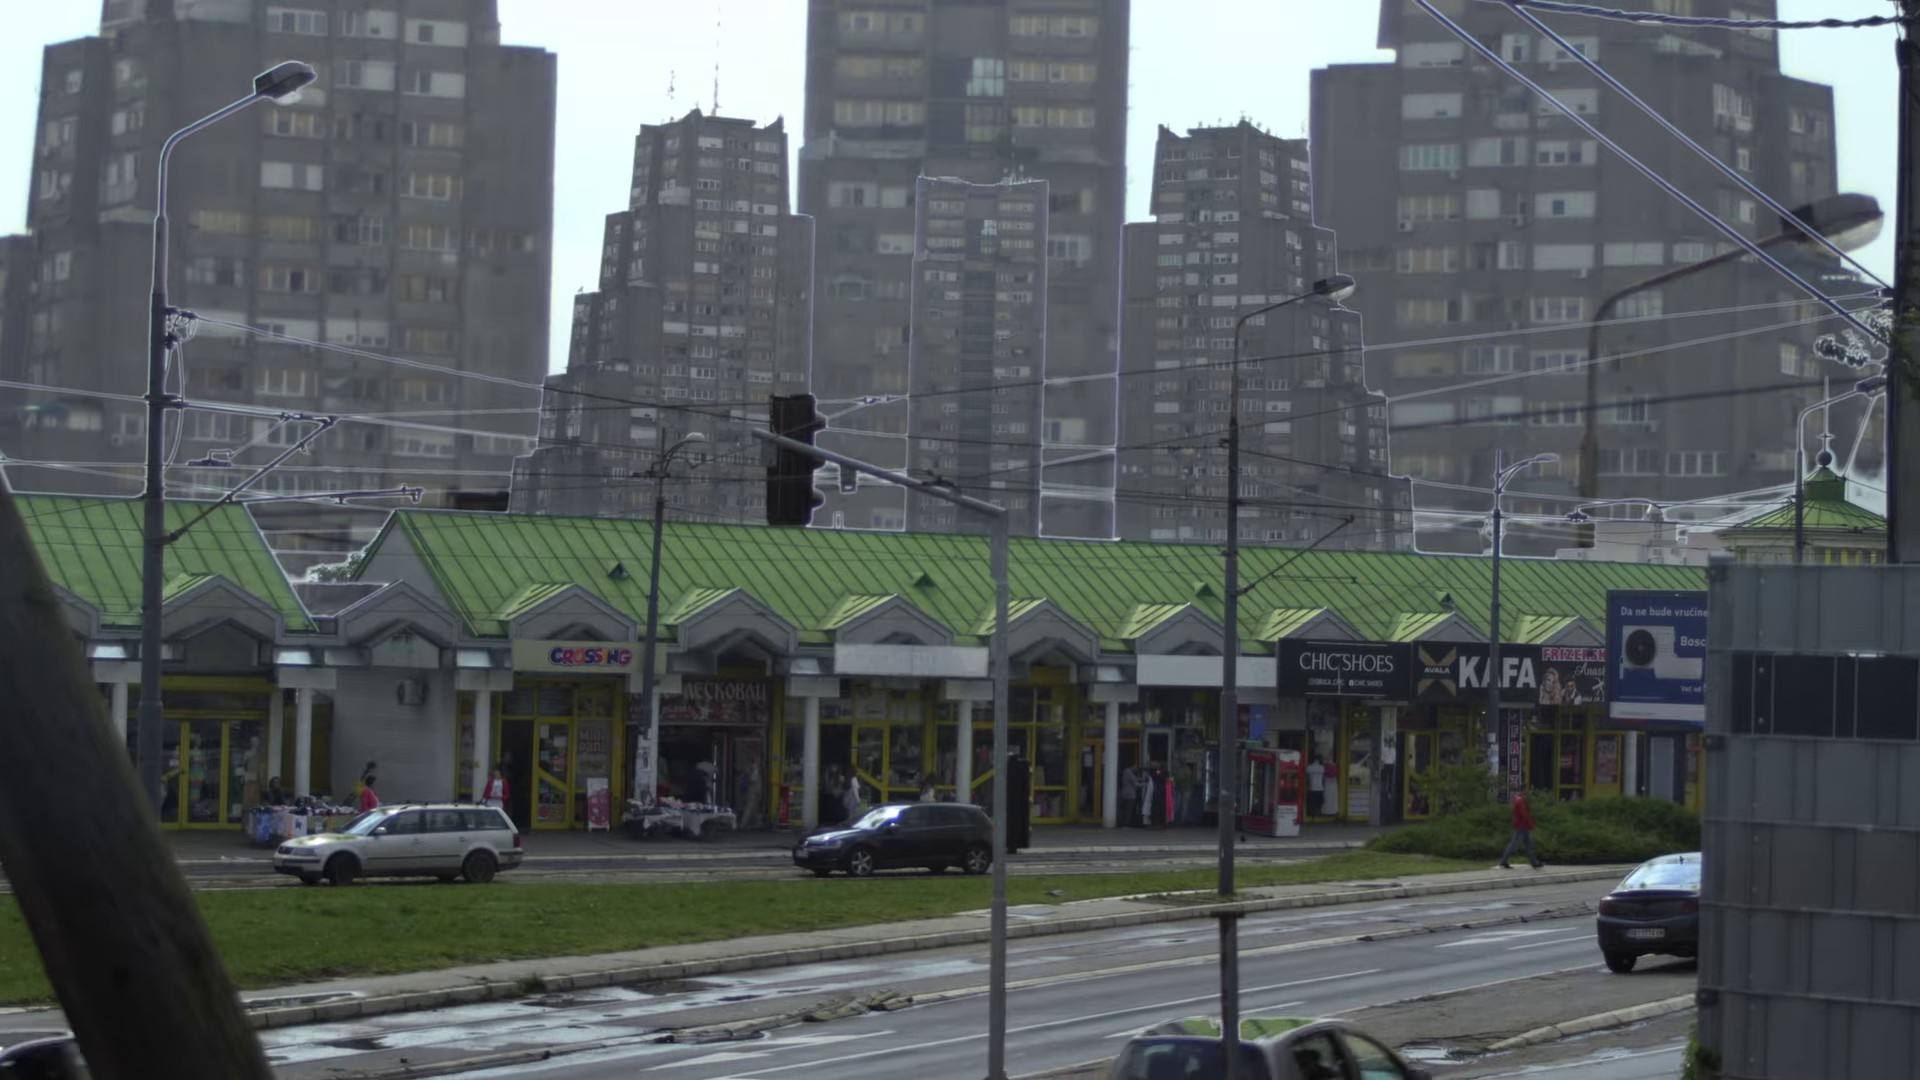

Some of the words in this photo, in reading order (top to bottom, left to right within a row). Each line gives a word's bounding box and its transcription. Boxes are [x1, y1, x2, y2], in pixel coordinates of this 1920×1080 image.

[1620, 606, 1633, 616] Da
[1635, 608, 1647, 616] ne
[1649, 606, 1672, 617] bude
[549, 647, 633, 666] CROSSING
[1299, 652, 1338, 671] CHIC
[1342, 653, 1393, 673] SHOES
[1458, 656, 1537, 688] KAFA
[684, 682, 766, 702] ЛЕСКОВАЦ
